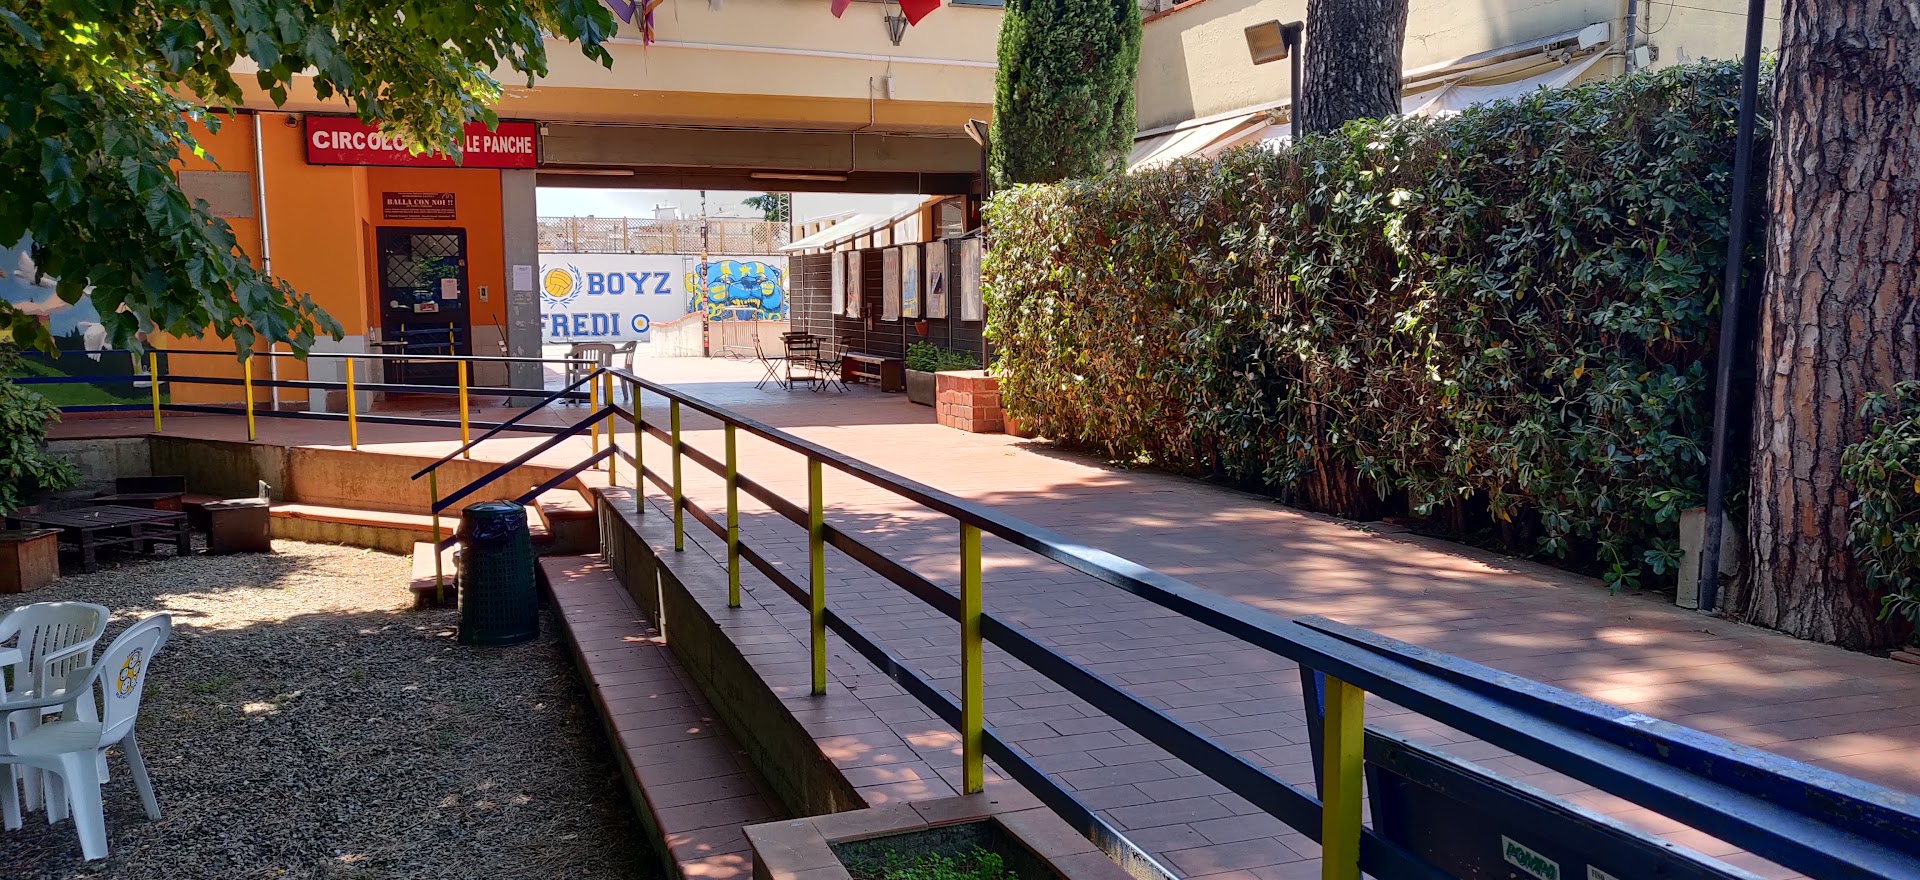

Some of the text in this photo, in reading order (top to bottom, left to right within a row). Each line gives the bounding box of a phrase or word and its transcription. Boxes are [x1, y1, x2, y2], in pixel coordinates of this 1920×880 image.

[312, 130, 408, 151] CIRCOLO
[466, 134, 480, 152] LE
[483, 135, 533, 154] PANCHE
[387, 198, 412, 206] BALLA
[587, 272, 672, 295] BOYZ
